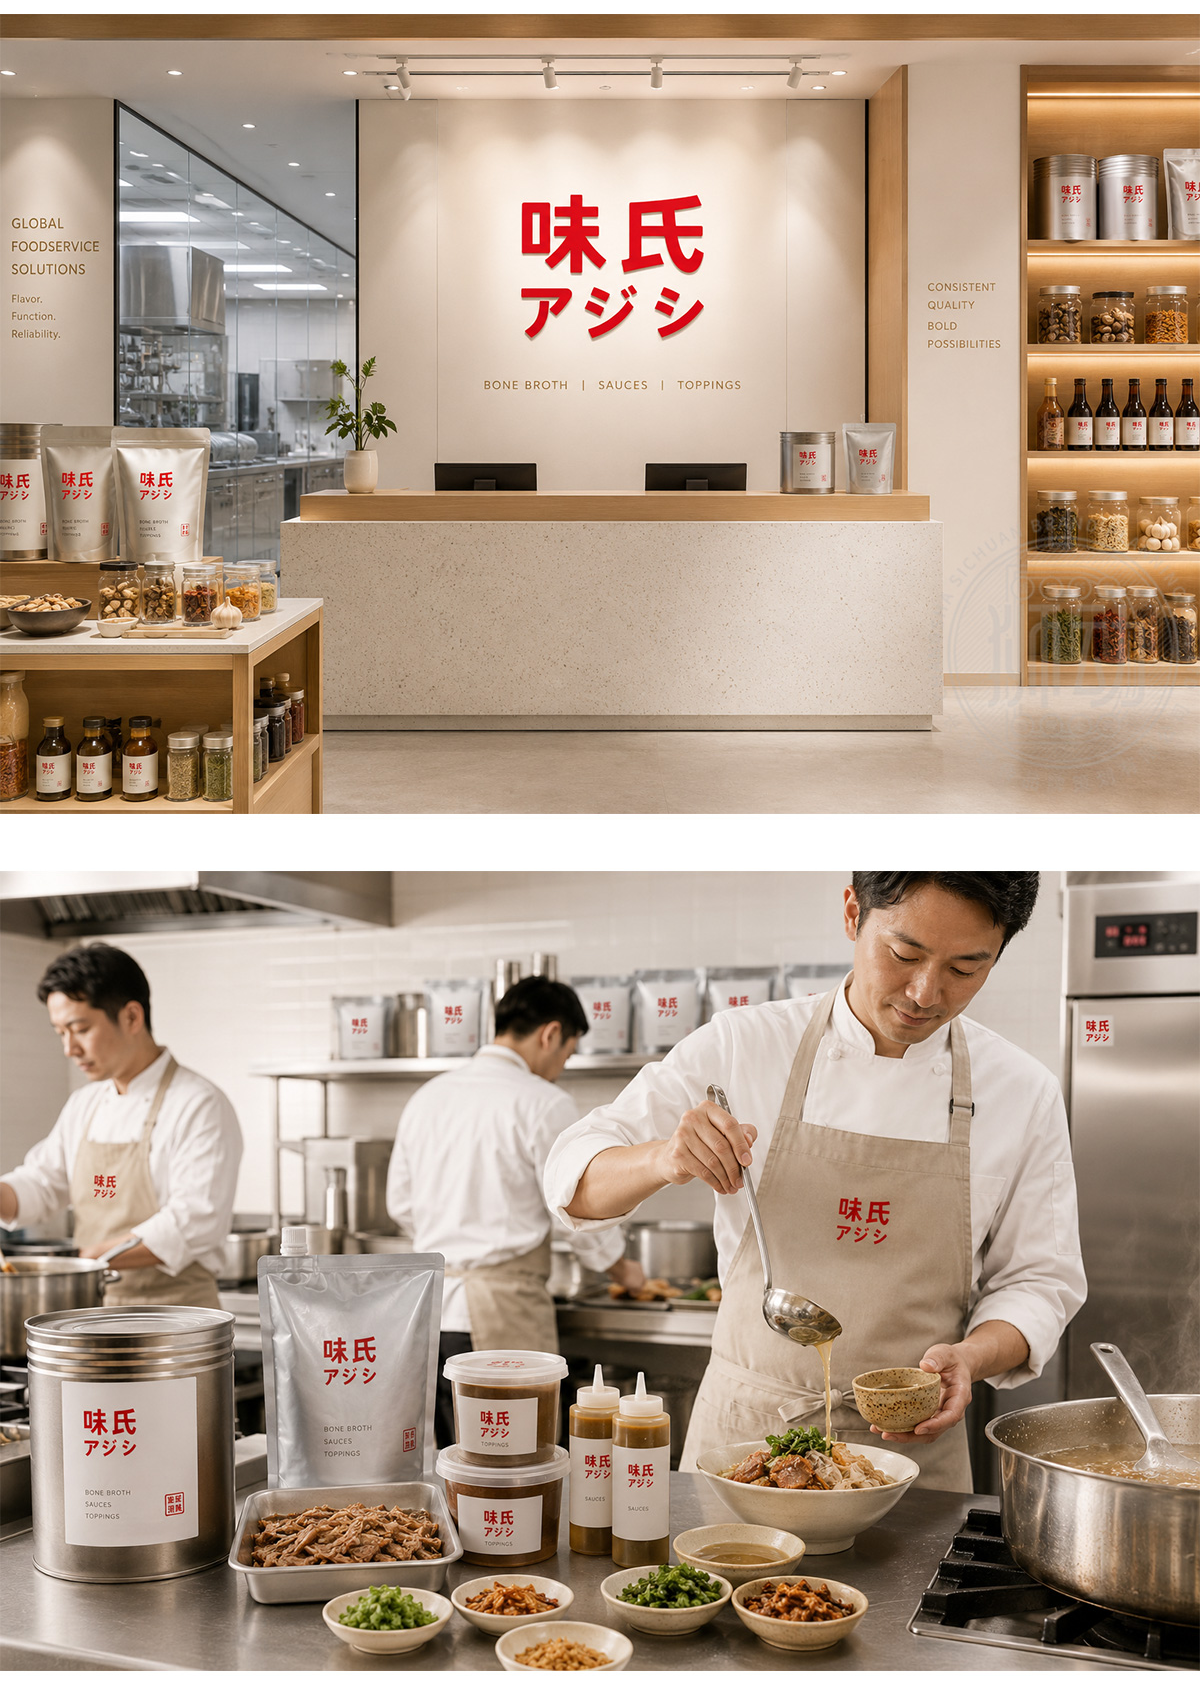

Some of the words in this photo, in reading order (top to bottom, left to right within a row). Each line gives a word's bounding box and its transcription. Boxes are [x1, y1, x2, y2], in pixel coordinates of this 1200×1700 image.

[11, 217, 64, 230] GLOBAL
[521, 194, 704, 274] 味氏
[11, 240, 100, 253] FOODSERVICE
[11, 263, 86, 275] SOLUTIONS
[927, 282, 996, 292] CONSISTENT
[11, 294, 43, 304] Flavor.
[927, 300, 975, 311] QUALITY
[11, 311, 56, 321] Function.
[521, 284, 705, 339] アジシ
[927, 321, 958, 331] BOLD
[11, 329, 61, 341] Reliability.
[927, 339, 1001, 349] POSSIBILITIES
[484, 380, 519, 390] BONE
[525, 380, 568, 390] BROTH
[598, 380, 648, 390] SAUCES
[677, 380, 742, 390] TOPPINGS
[61, 471, 93, 488] 味氏
[139, 471, 173, 488] 味氏
[61, 489, 93, 500] アジシ
[139, 489, 172, 500] アジシ
[1086, 1020, 1109, 1032] 味氏
[1086, 1033, 1109, 1042] アジシ
[93, 1189, 116, 1198] アジシ
[838, 1197, 890, 1225] 味氏
[836, 1225, 887, 1244] アジシ
[323, 1336, 377, 1364] 味氏
[323, 1367, 377, 1386] アジシ
[83, 1408, 136, 1436] 味氏
[323, 1424, 344, 1433] BONE
[347, 1424, 373, 1433] BROTH
[480, 1427, 510, 1439] アジシ
[84, 1439, 136, 1457] アジシ
[584, 1455, 611, 1468] 味氏
[584, 1469, 611, 1479] アジシ
[628, 1478, 654, 1488] アジシ
[106, 1488, 131, 1496] BROTH
[85, 1512, 120, 1520] TOPPINGS
[484, 1527, 514, 1538] アジシ
